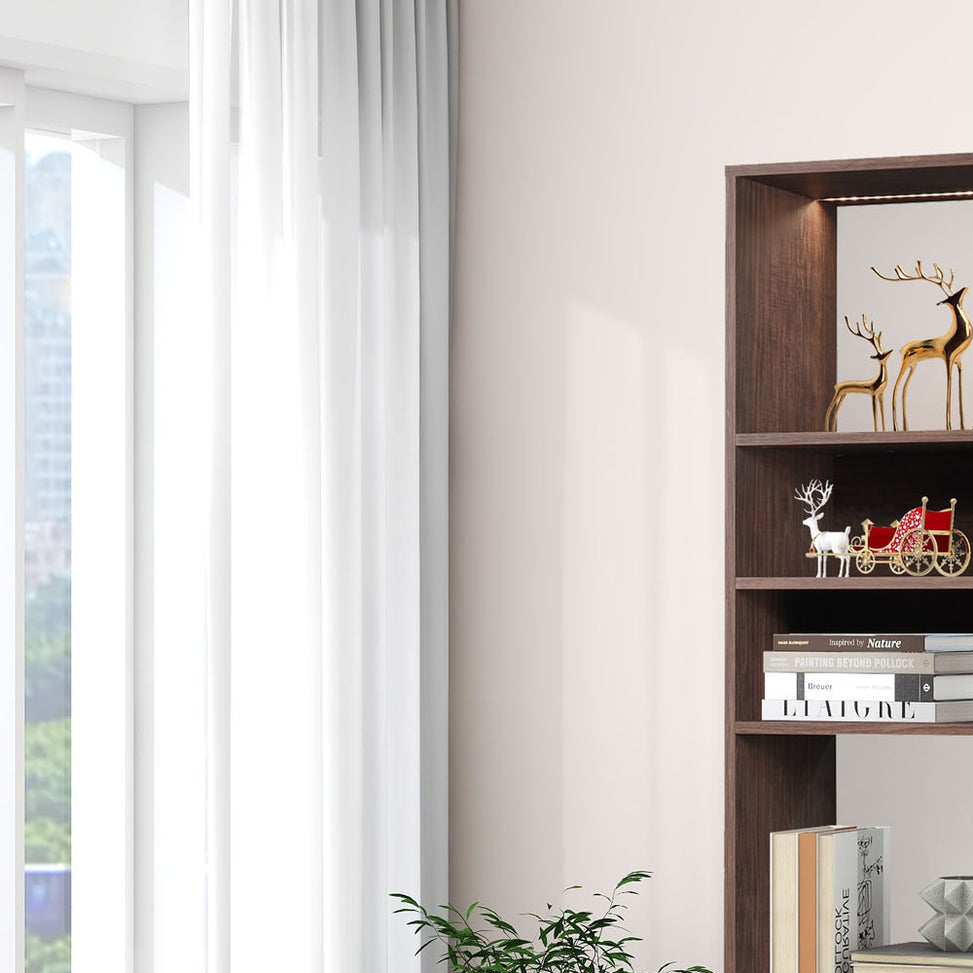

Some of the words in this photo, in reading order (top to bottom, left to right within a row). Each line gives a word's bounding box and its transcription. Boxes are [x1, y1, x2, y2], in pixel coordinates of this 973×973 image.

[856, 639, 864, 648] by
[867, 638, 902, 649] Nature
[795, 658, 835, 668] PAINTING
[837, 658, 872, 668] BEYOND
[874, 658, 914, 669] POLLOCK
